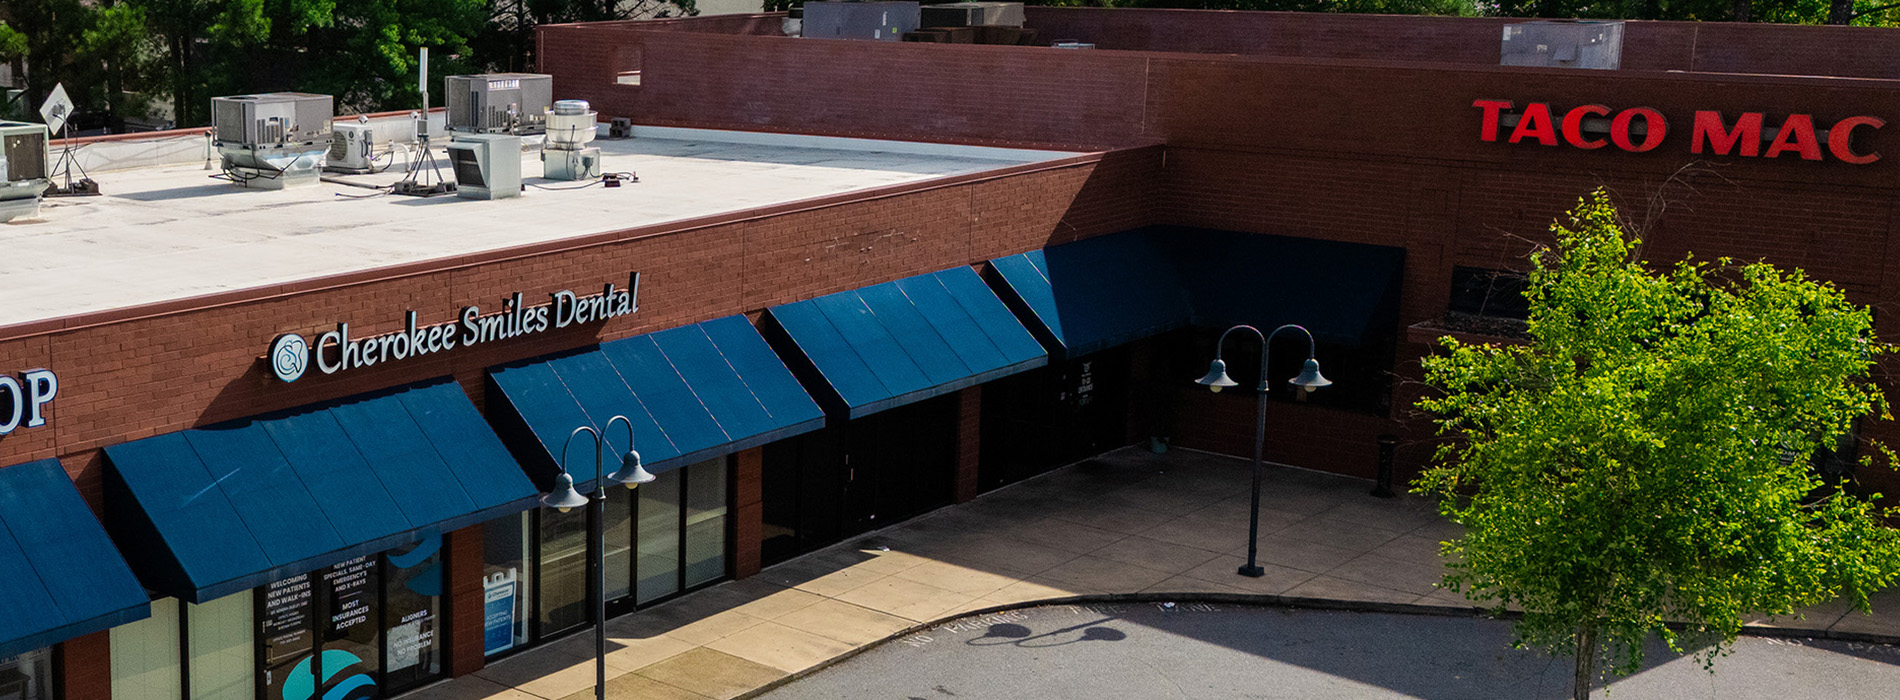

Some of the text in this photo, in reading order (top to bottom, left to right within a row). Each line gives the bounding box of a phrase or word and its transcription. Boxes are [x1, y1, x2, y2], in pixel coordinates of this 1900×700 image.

[1472, 99, 1887, 165] TACO MAC
[316, 271, 641, 374] Cherokee Smiles Dental
[333, 555, 366, 570] NEW PATIENT
[270, 573, 308, 589] WELCOMING
[335, 578, 366, 592] AND X-RAYS
[267, 581, 310, 599] NEW PATIENTS
[266, 598, 280, 609] AND
[281, 590, 311, 604] WALK-INS
[341, 599, 359, 610] MOST
[332, 605, 369, 622] INSURANCES
[335, 615, 367, 630] ACCEPTED
